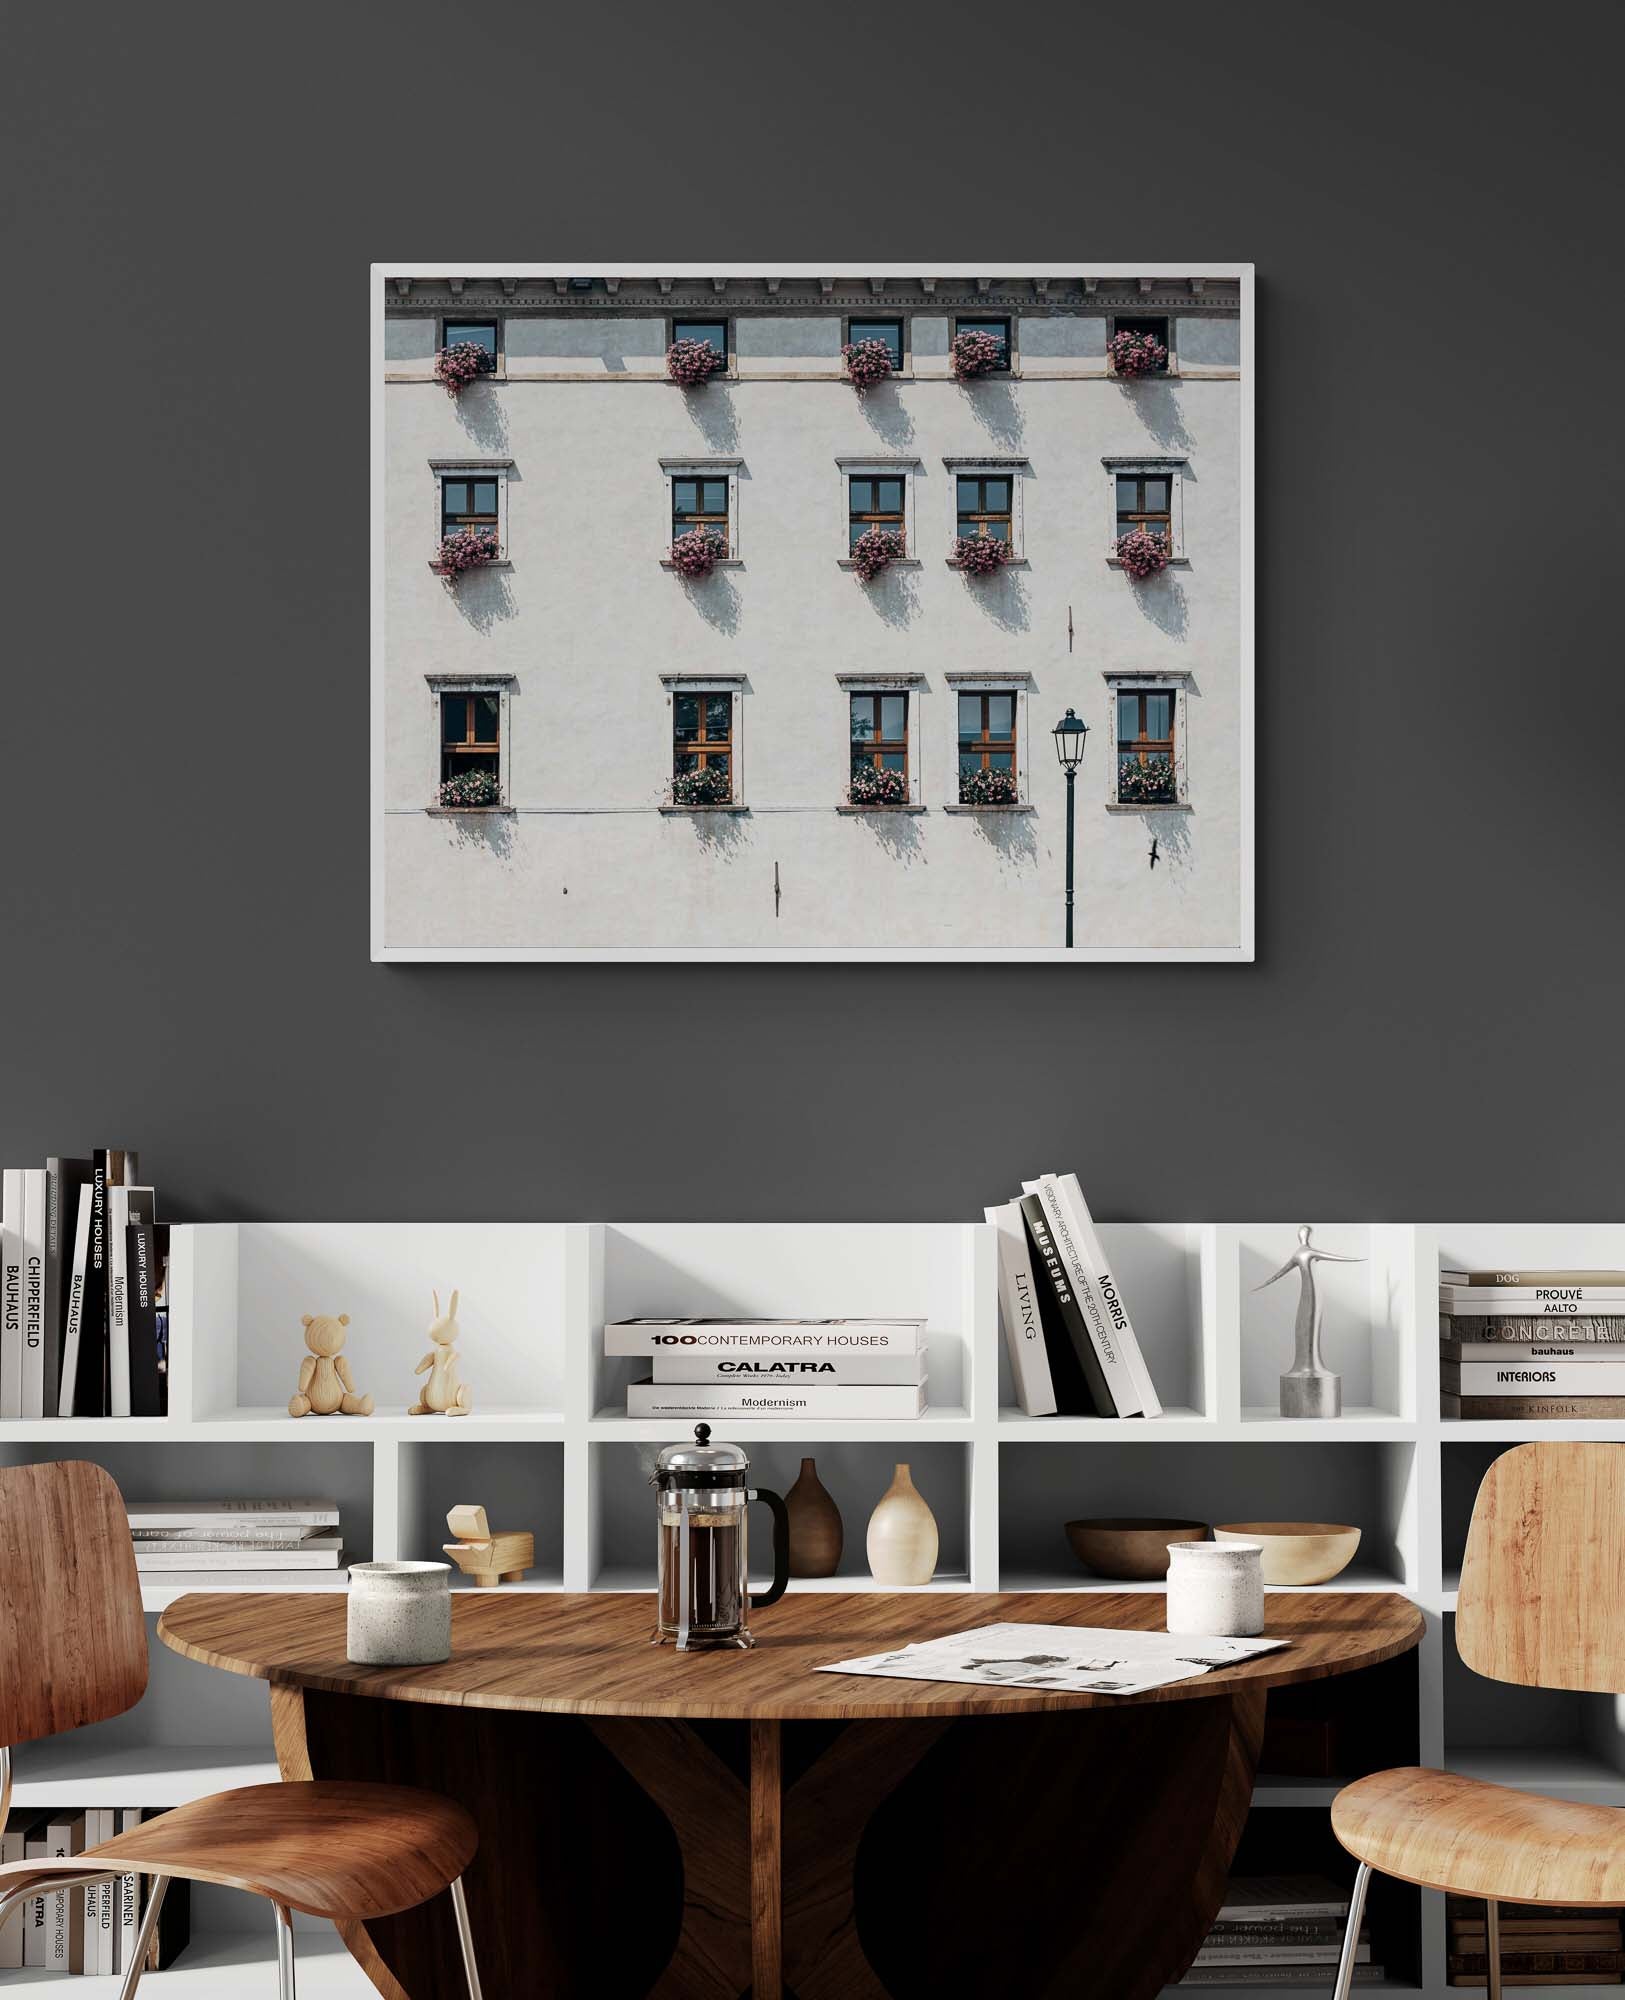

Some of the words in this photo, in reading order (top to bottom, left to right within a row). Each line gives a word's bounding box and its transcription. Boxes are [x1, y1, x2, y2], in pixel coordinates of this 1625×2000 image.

[94, 1169, 103, 1216] LUXURY
[1044, 1183, 1062, 1219] VISIONARY
[93, 1220, 103, 1269] HOUSES
[137, 1233, 147, 1268] LUXURY
[1032, 1220, 1071, 1304] MUSEUMS
[1058, 1220, 1084, 1276] ARCHITECTURE
[139, 1270, 148, 1308] HOUSES
[1078, 1276, 1088, 1287] OF
[1081, 1286, 1094, 1304] THE
[1496, 1274, 1520, 1283] DOG
[1536, 1288, 1583, 1300] PROUVÉ
[6, 1265, 19, 1330] BAUHAUS
[27, 1257, 41, 1348] CHIPPERFIELD
[68, 1275, 82, 1334] BAUHAUS
[114, 1276, 123, 1326] Modernism
[1015, 1273, 1036, 1340] LIVING
[1088, 1303, 1102, 1327] 20TH
[1098, 1274, 1127, 1330] MORRIS
[1544, 1304, 1577, 1312] AALTO
[827, 1335, 889, 1346] HOUSES
[1096, 1326, 1117, 1363] CENTURY
[1485, 1325, 1608, 1340] CONCRETE
[717, 1361, 836, 1373] CALATRA
[1531, 1348, 1574, 1356] bauhaus
[1497, 1372, 1556, 1382] INTERIORS
[742, 1398, 807, 1407] Modernism
[35, 1896, 45, 1928] ATRA
[87, 1885, 96, 1918] UHAUS
[101, 1884, 110, 1929] PPERFIELD
[123, 1875, 133, 1926] SAARINEN
[54, 1929, 64, 1959] HOUSES
